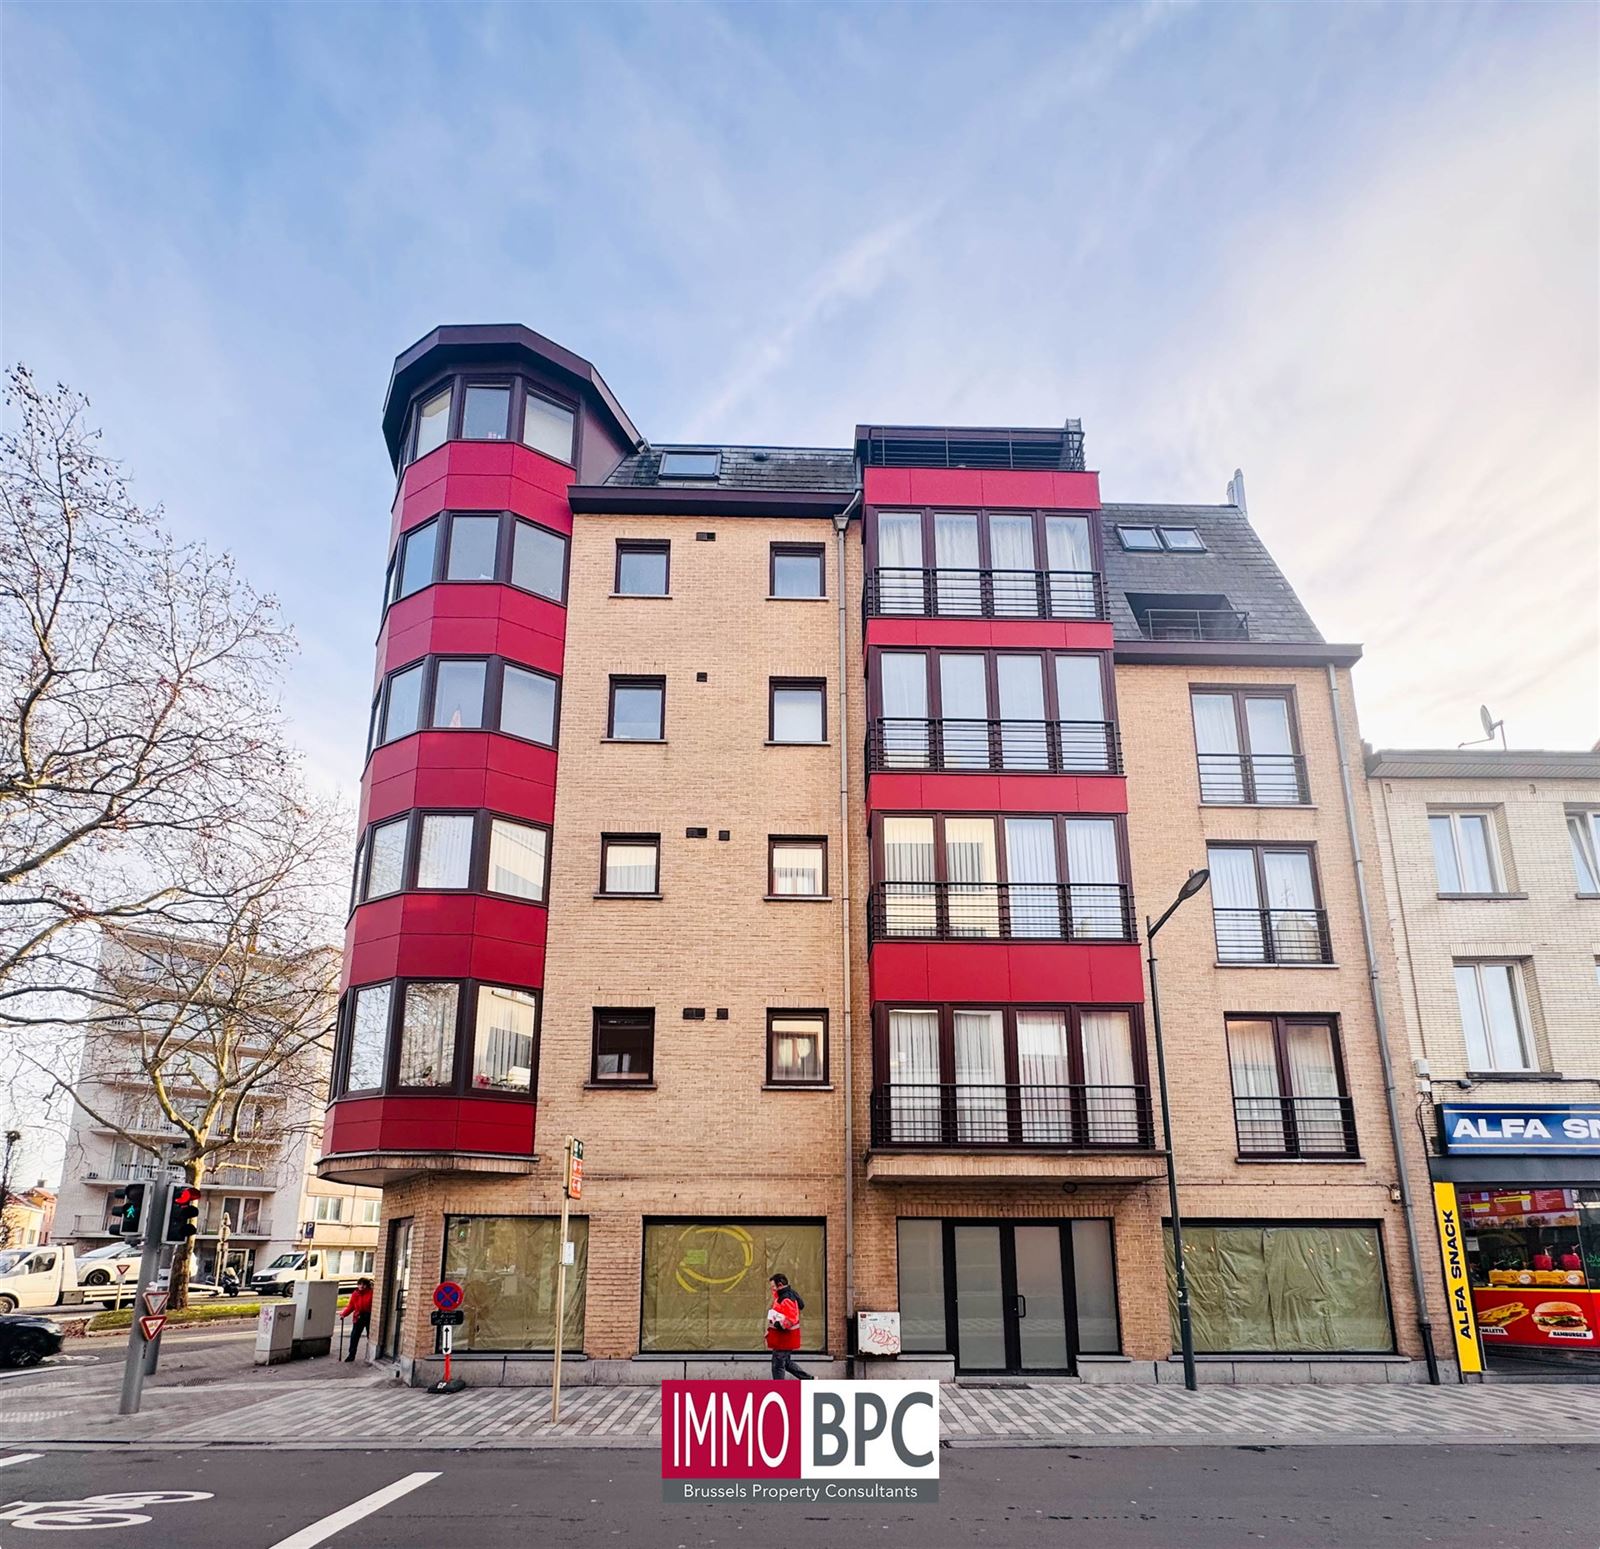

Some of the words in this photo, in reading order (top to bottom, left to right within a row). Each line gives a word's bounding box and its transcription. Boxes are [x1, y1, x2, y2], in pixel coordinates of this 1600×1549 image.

[1452, 1118, 1552, 1139] ALFA
[1442, 1209, 1462, 1279] SNACK
[1454, 1285, 1472, 1340] ALFA
